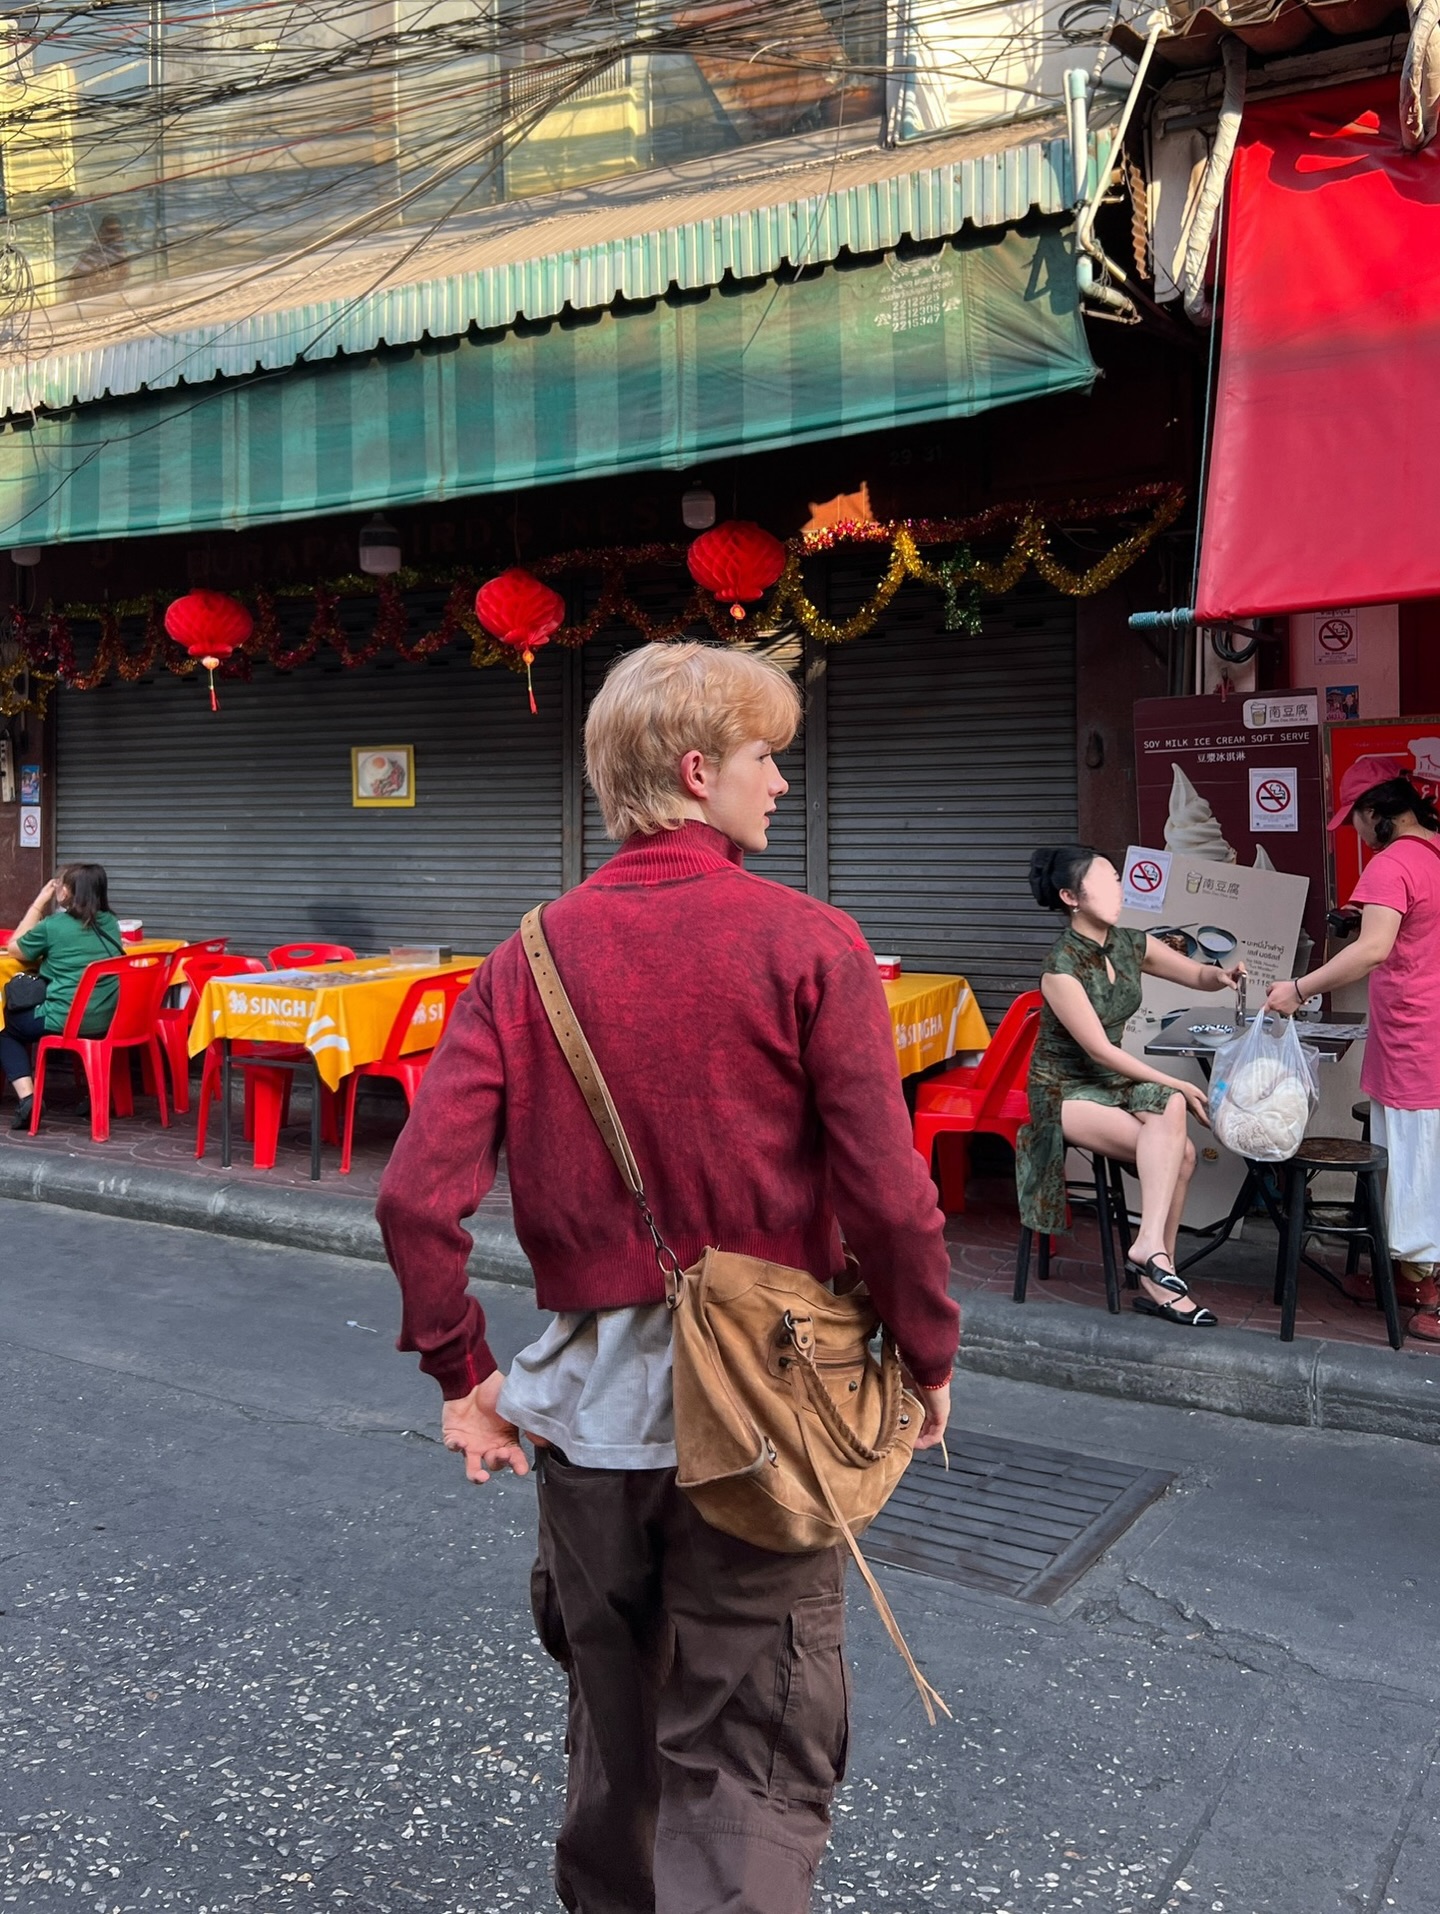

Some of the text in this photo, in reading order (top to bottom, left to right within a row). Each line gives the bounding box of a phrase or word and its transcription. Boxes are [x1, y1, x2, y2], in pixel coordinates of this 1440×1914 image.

[892, 303, 940, 321] 2212306
[892, 313, 941, 332] 2215347
[1143, 732, 1310, 749] SOY MILK ICE CREAM SOFT SERVE
[907, 1013, 944, 1046] SINGHA
